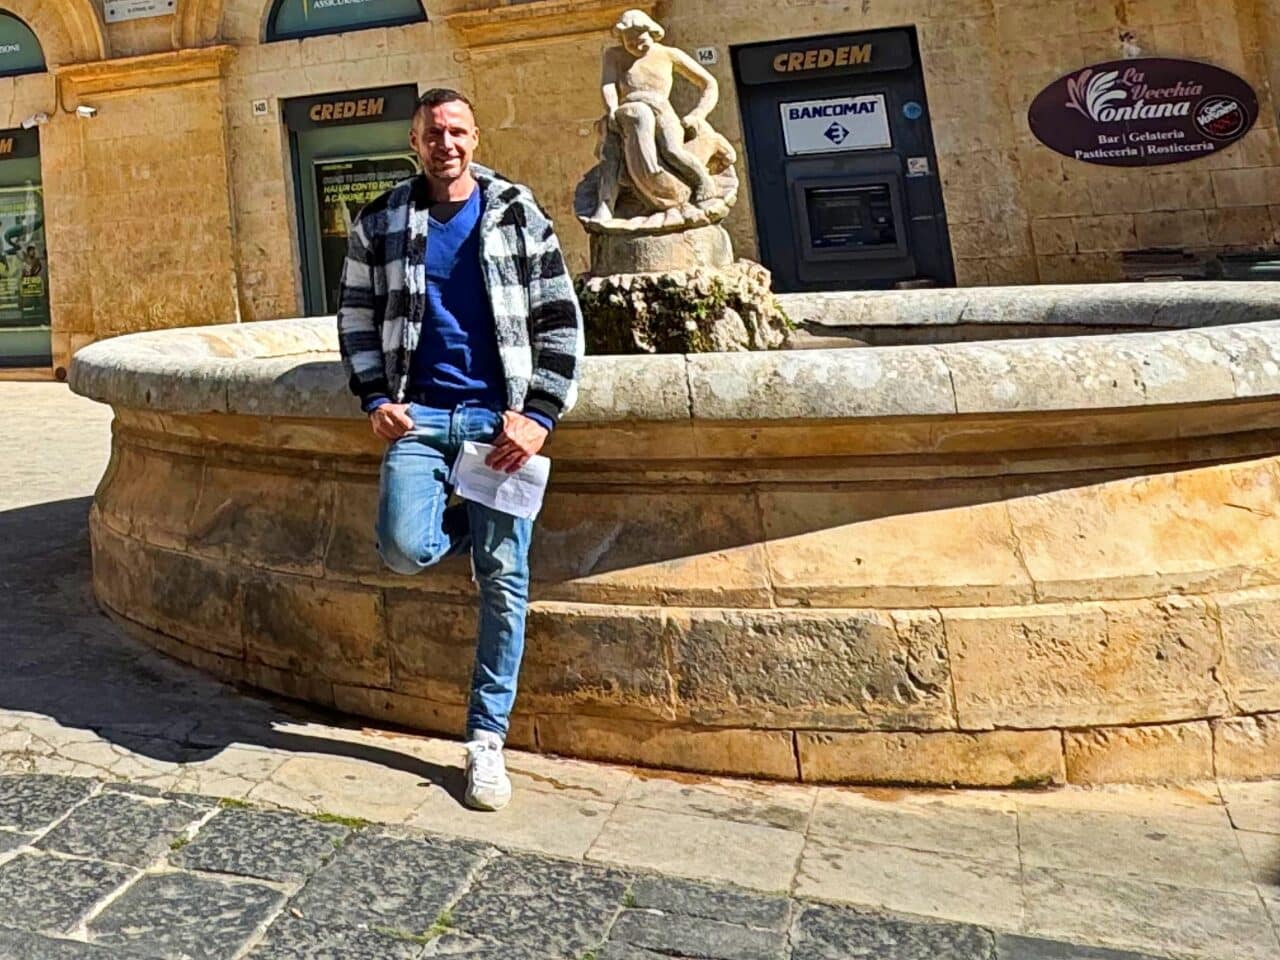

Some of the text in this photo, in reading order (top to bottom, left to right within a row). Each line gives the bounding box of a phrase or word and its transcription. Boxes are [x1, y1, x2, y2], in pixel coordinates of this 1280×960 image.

[773, 43, 872, 72] CREDEM
[1122, 67, 1145, 83] La
[1131, 80, 1203, 100] Vecchia
[310, 97, 385, 121] CREDEM
[789, 100, 878, 121] BANCOMAT
[1098, 129, 1185, 145] Bar Gelateria
[1074, 141, 1214, 160] Pasticceria Rosticceria
